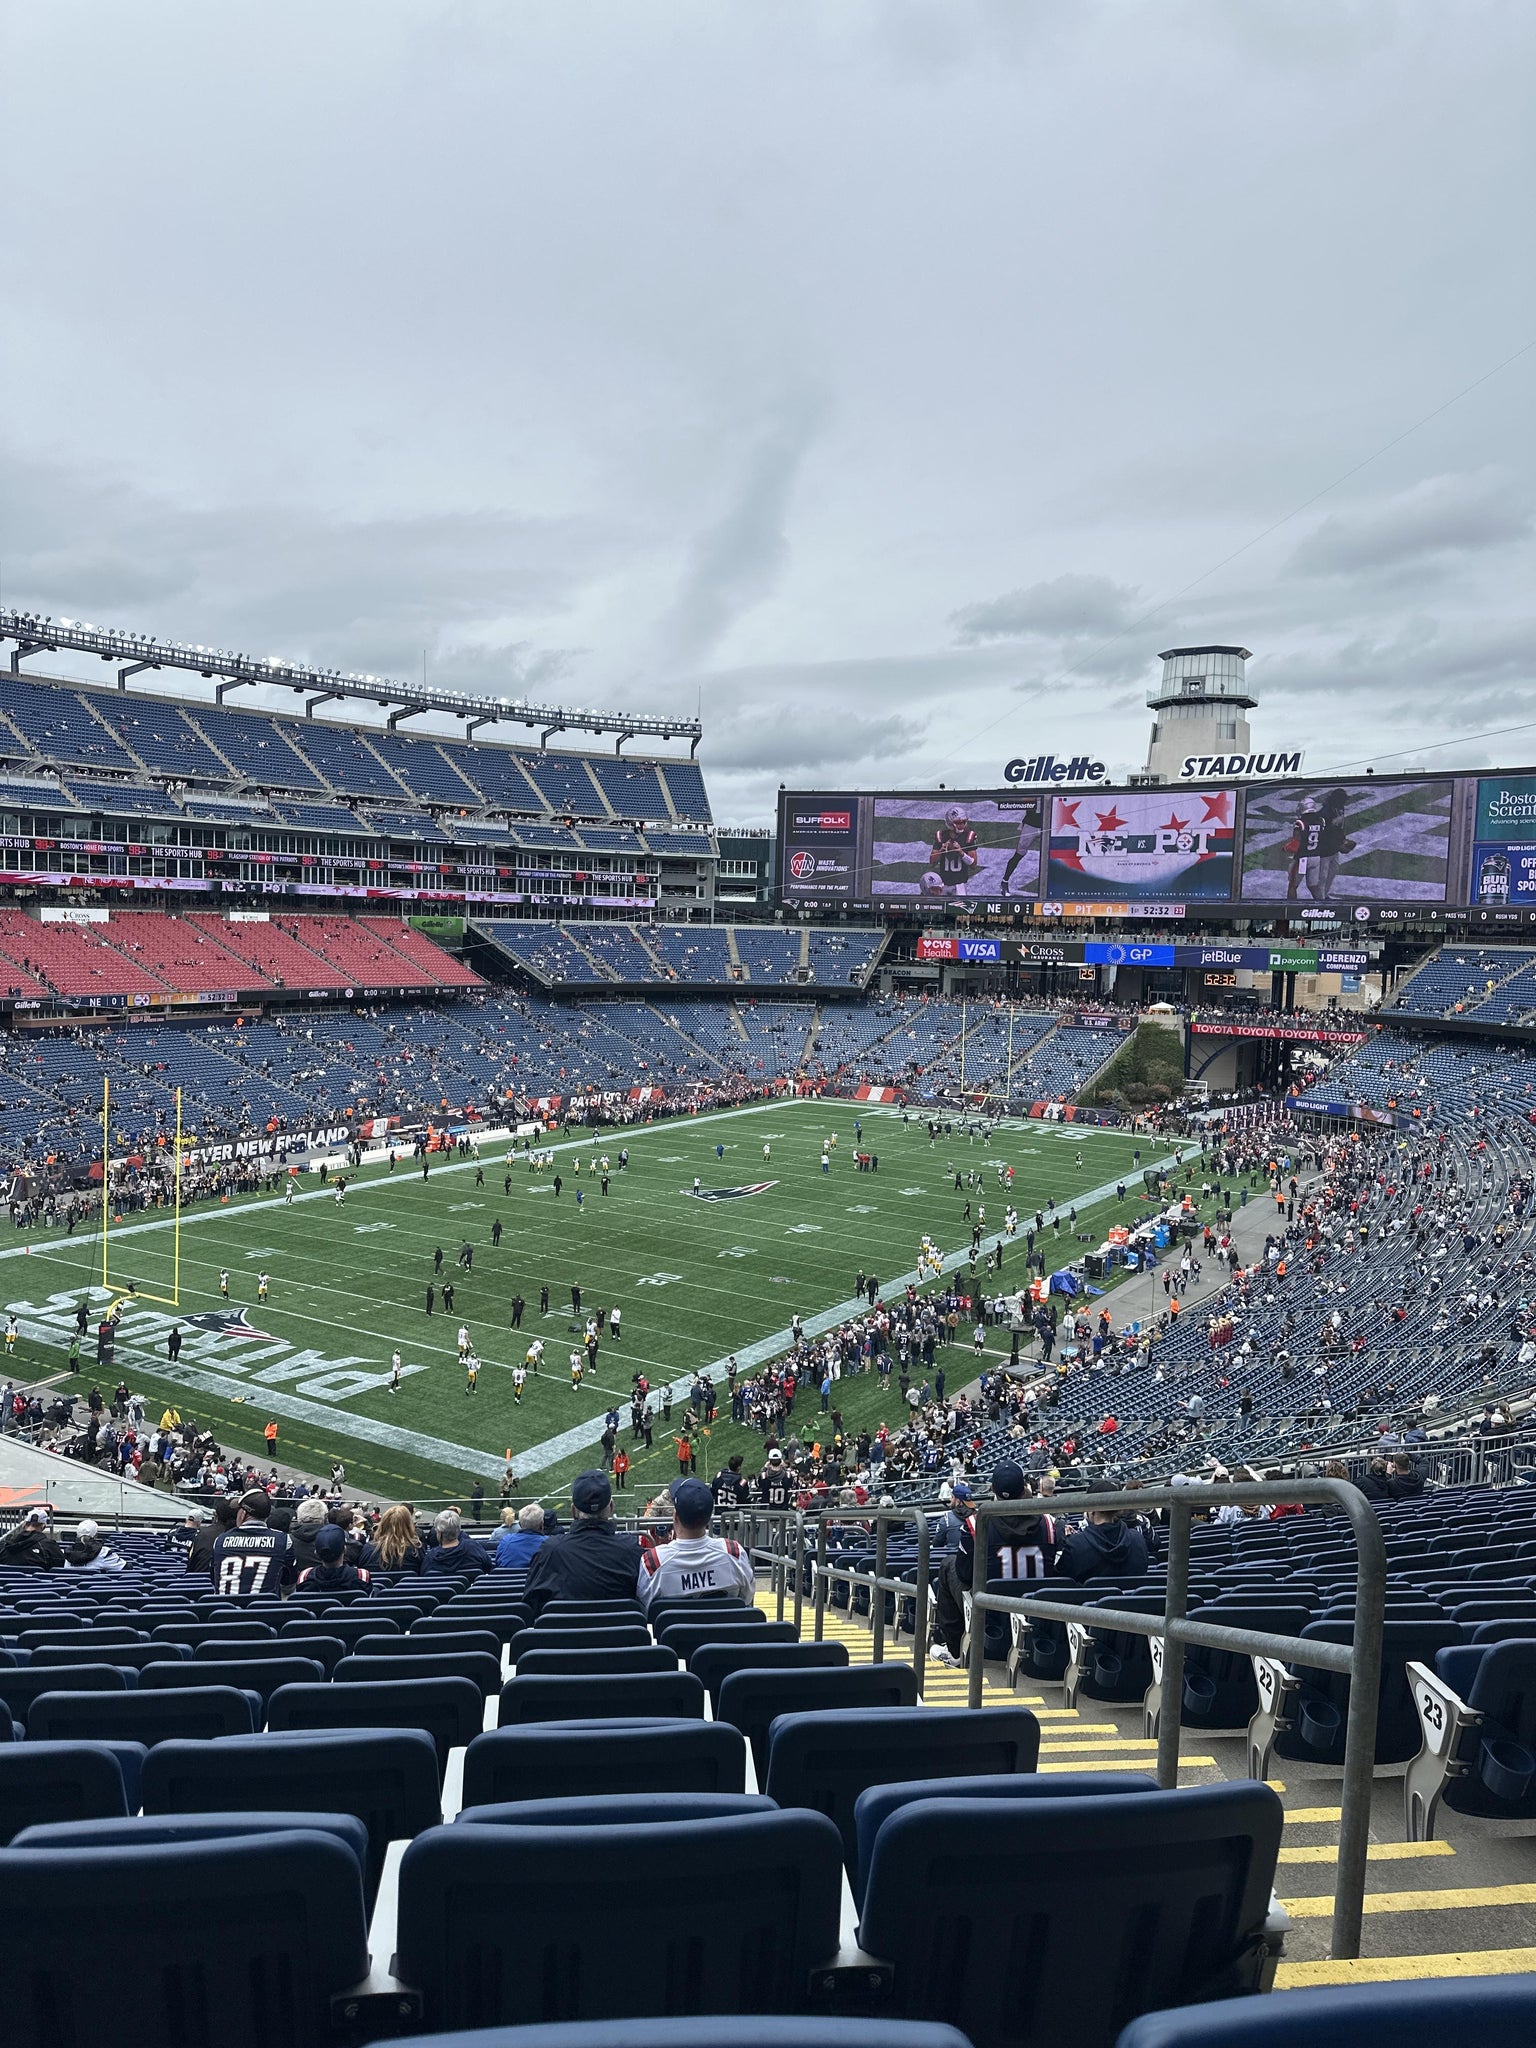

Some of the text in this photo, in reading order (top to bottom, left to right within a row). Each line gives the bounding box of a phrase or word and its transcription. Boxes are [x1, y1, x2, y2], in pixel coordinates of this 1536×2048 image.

[1004, 756, 1105, 782] Gillette
[1181, 753, 1301, 776] STADIUM
[1076, 830, 1129, 856] NE
[1307, 832, 1319, 850] 9
[14, 839, 30, 848] HUB
[35, 840, 55, 849] 98.5
[60, 842, 83, 850] BOSTON'S
[83, 843, 97, 851] HOME
[128, 846, 146, 855] 98.5
[151, 848, 163, 856] THE
[164, 849, 188, 857] SPORTS
[189, 850, 202, 858] HUB
[207, 850, 224, 859] 98.5
[302, 856, 317, 865] 98.5
[332, 859, 353, 867] SPORTS
[354, 860, 366, 868] HUB
[369, 860, 384, 869] 98.5
[944, 856, 962, 872] 10
[1483, 875, 1507, 884] BUD
[1480, 884, 1509, 894] LIGHT
[987, 904, 1001, 913] NE
[1014, 904, 1020, 913] 0
[1075, 906, 1093, 914] PIT
[1144, 907, 1169, 915] 52:32
[1301, 909, 1335, 918] Gillette
[932, 940, 952, 949] CVS
[962, 944, 996, 956] VISA
[1201, 950, 1241, 964] jetBlue
[1318, 954, 1366, 964] J.DERENZO
[1081, 969, 1094, 979] 25
[1206, 974, 1236, 985] 52:32
[89, 998, 101, 1006] NE
[1196, 1024, 1363, 1042] TOYOTA TOYOTA TOYOTA TOYOTA
[235, 1126, 349, 1158] NEW ENGLAND
[717, 1489, 737, 1508] 25
[769, 1488, 785, 1504] 10
[223, 1536, 275, 1548] GRONKOWSKI
[997, 1546, 1044, 1578] 10
[219, 1556, 271, 1594] 87
[681, 1570, 716, 1591] MAYE
[1070, 1630, 1077, 1649] 20
[1153, 1644, 1162, 1668] 21
[1260, 1665, 1272, 1695] 22
[1424, 1694, 1443, 1730] 23
